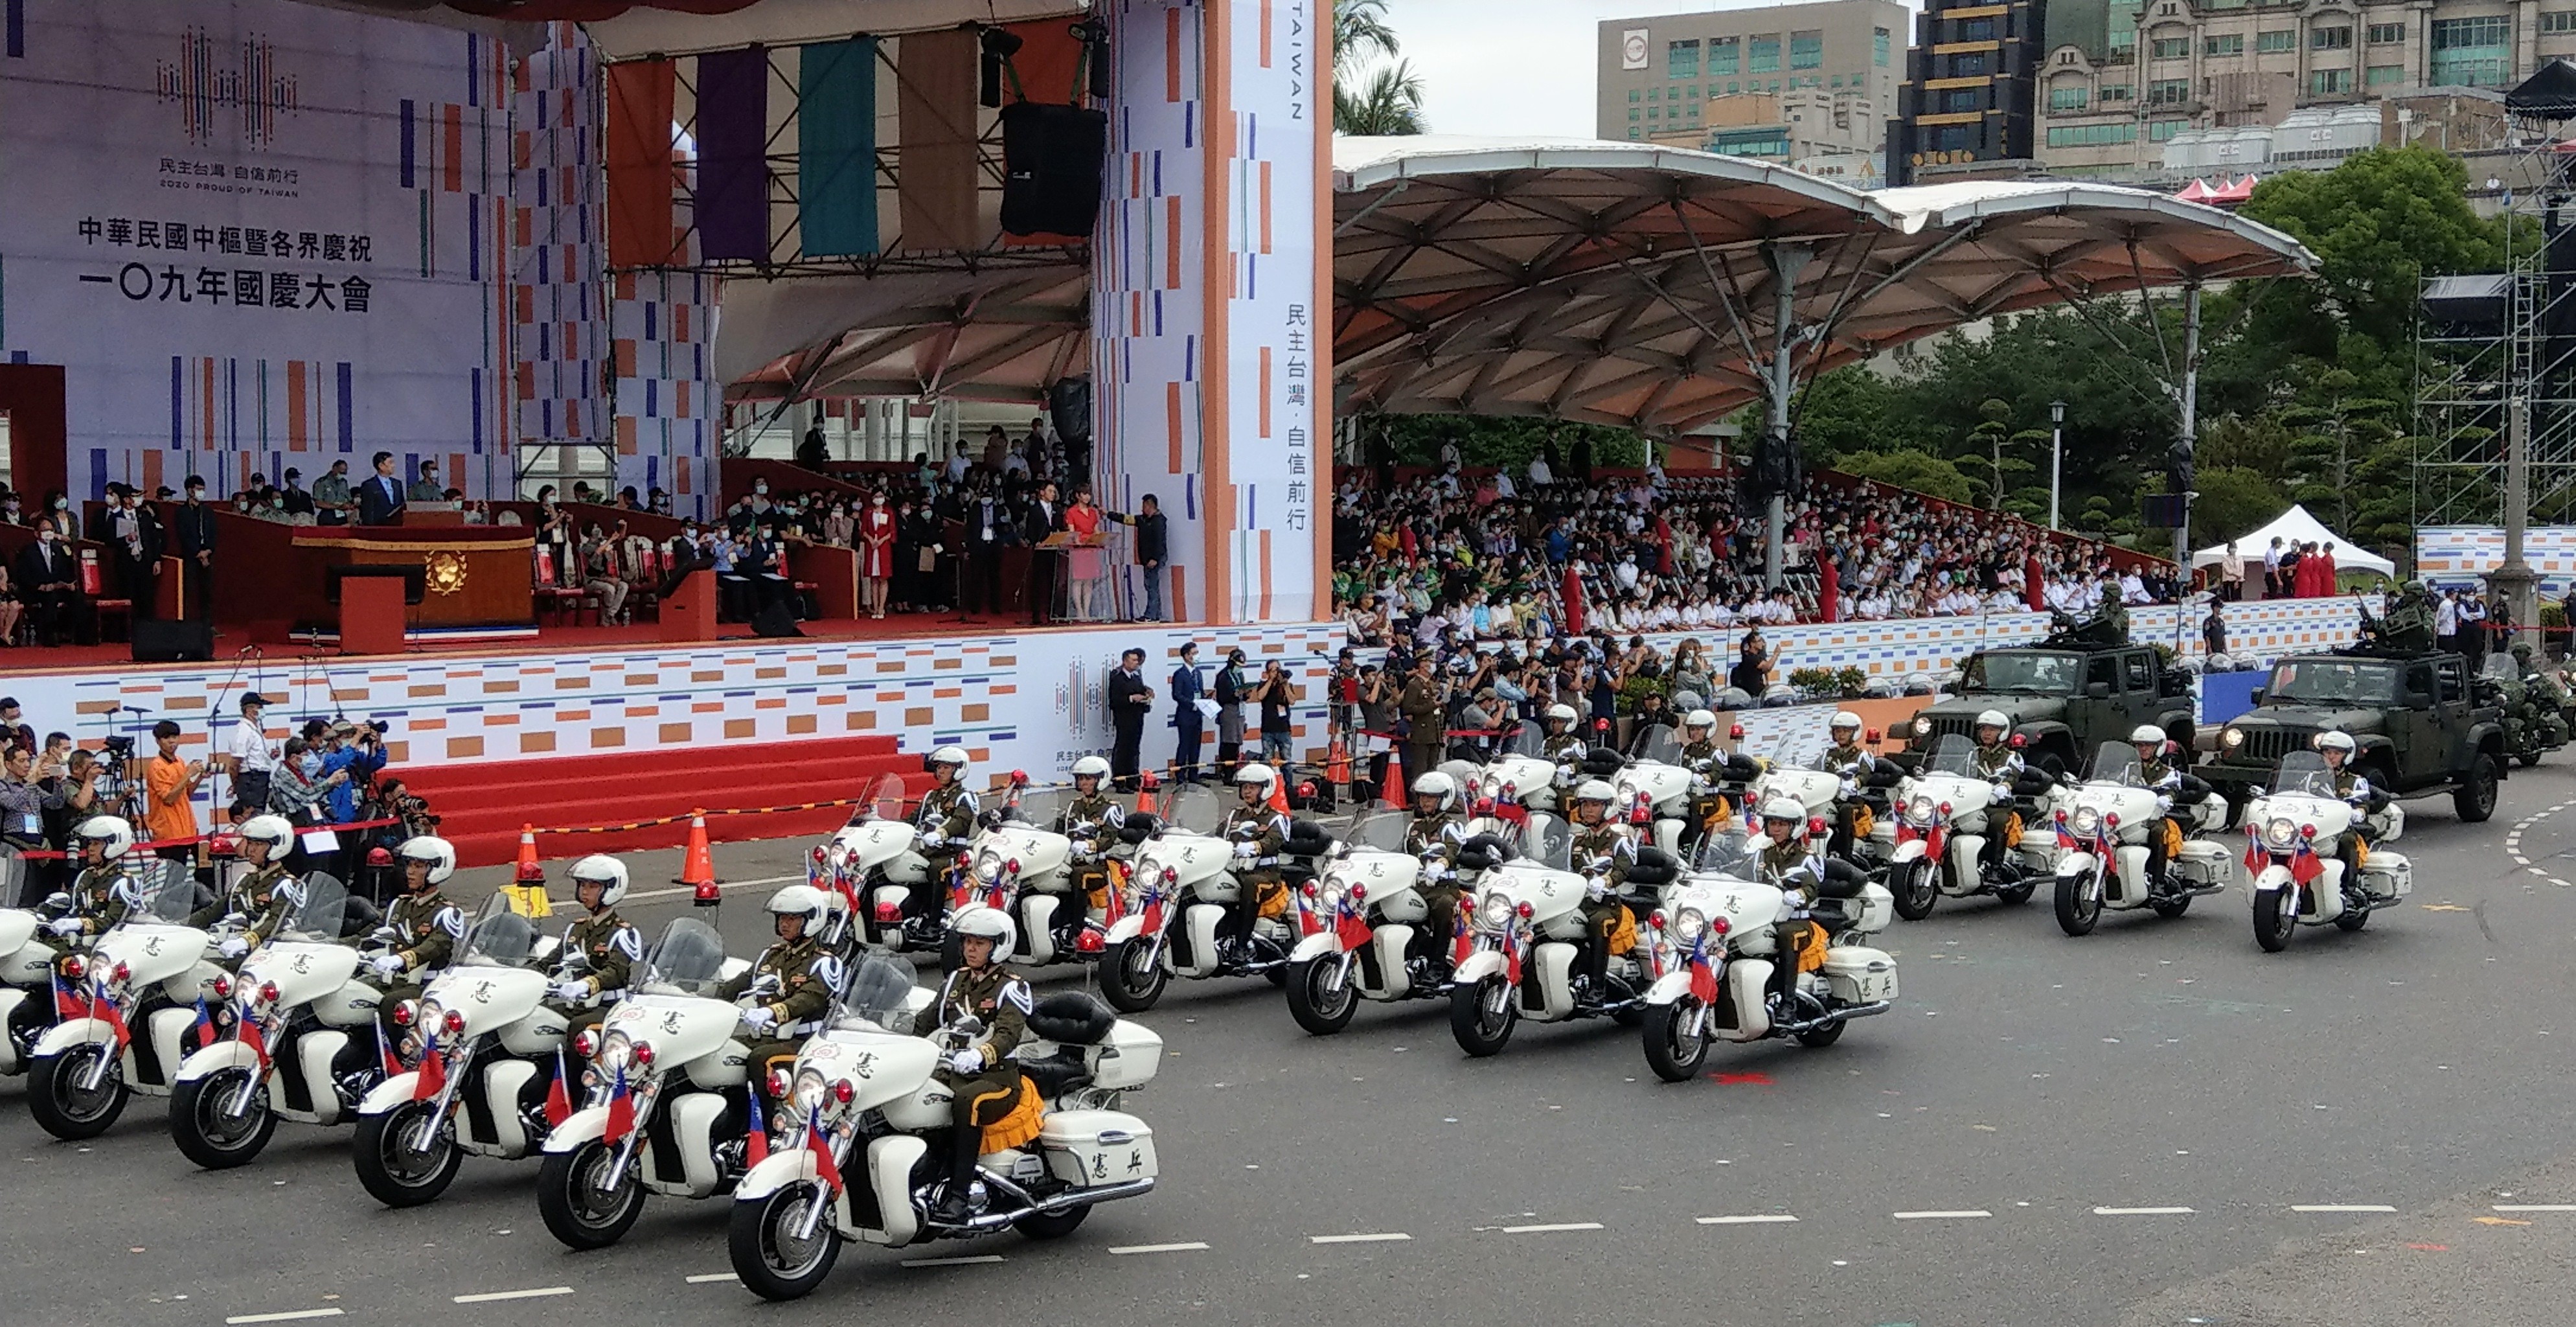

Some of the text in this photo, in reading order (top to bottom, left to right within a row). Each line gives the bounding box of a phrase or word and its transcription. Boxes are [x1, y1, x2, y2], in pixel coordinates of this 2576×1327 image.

[1292, 2, 1303, 119] TAIWAN
[196, 182, 233, 193] PROUD
[238, 186, 253, 194] OF
[258, 188, 298, 198] TAIWAN
[78, 216, 372, 262] 中華民國中樞暨各界慶祝
[1092, 1148, 1142, 1179] 憲兵
